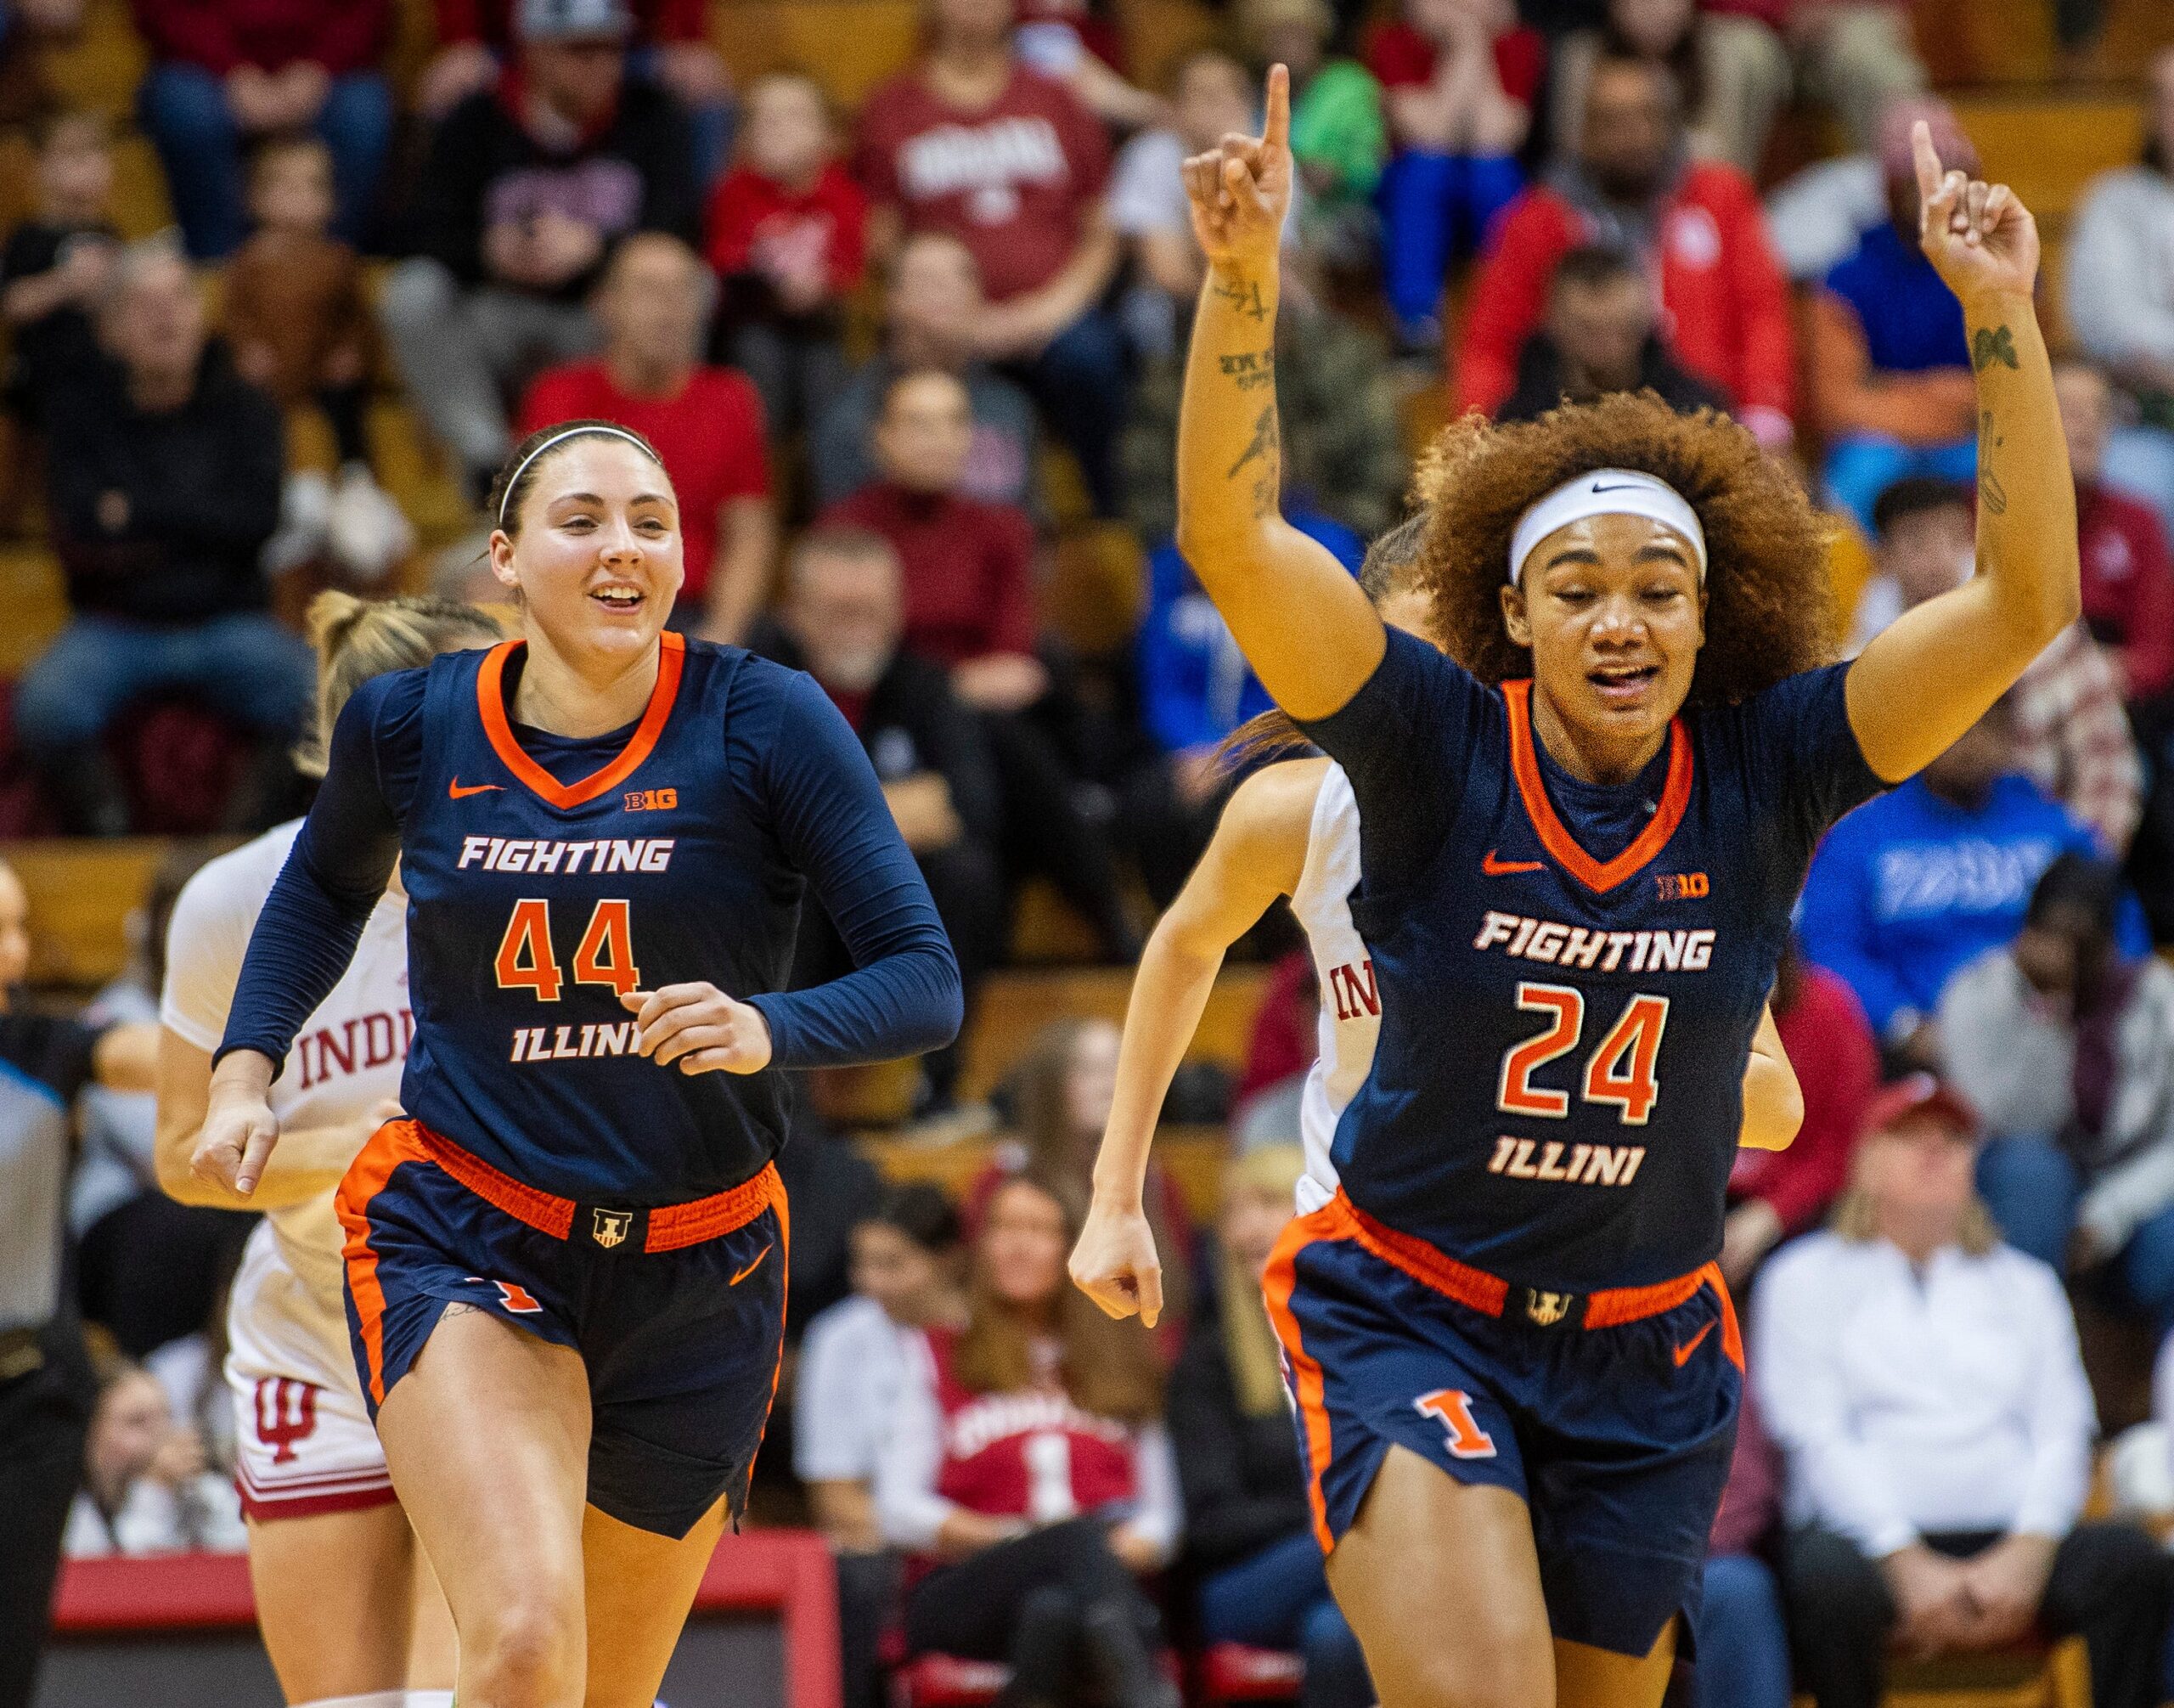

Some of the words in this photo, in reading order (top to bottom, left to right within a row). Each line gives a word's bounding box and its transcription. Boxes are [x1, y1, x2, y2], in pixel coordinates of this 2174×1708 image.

[456, 836, 676, 875] FIGHTING
[494, 899, 641, 1001] 44
[1473, 910, 1716, 972] FIGHTING
[1496, 981, 1670, 1125] 24
[1487, 1135, 1647, 1187] ILLINI
